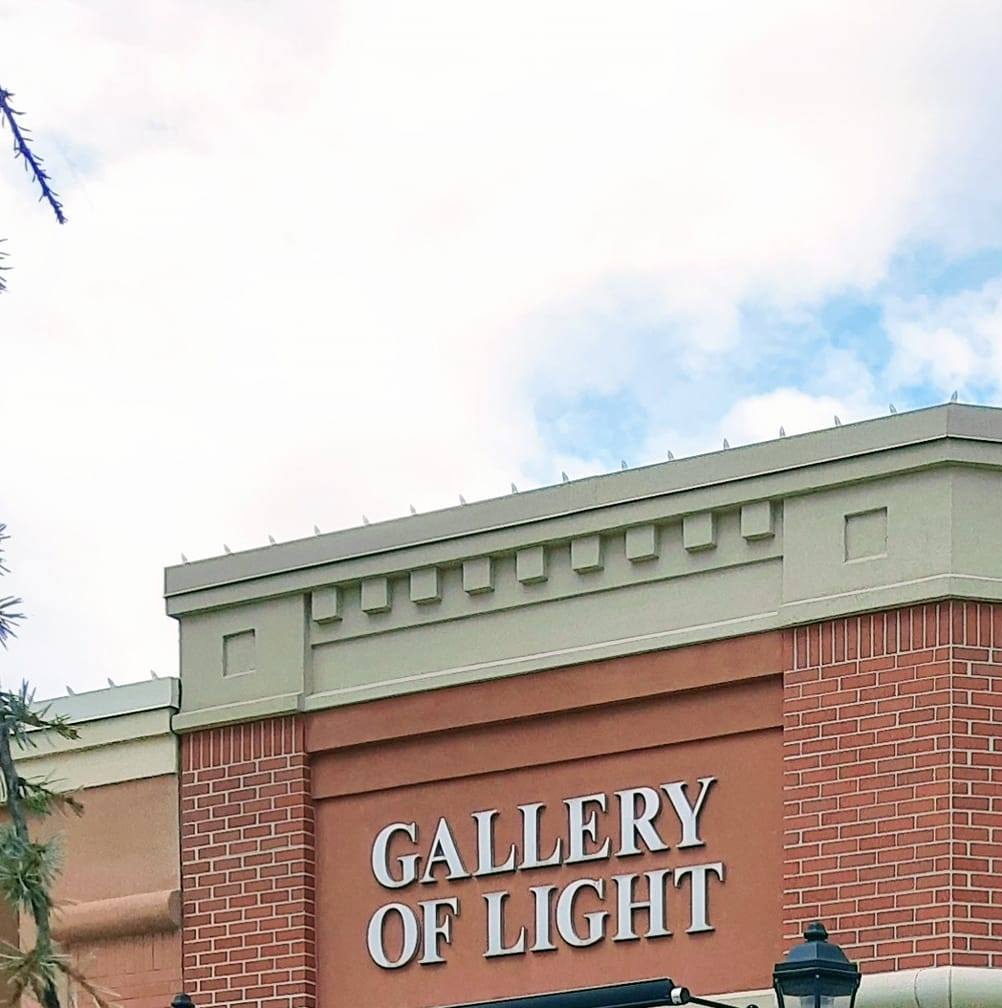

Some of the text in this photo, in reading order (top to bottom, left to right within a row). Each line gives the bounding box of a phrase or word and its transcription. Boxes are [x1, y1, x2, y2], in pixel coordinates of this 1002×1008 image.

[371, 776, 717, 889] GALLERY
[366, 862, 724, 969] OF LIGHT
